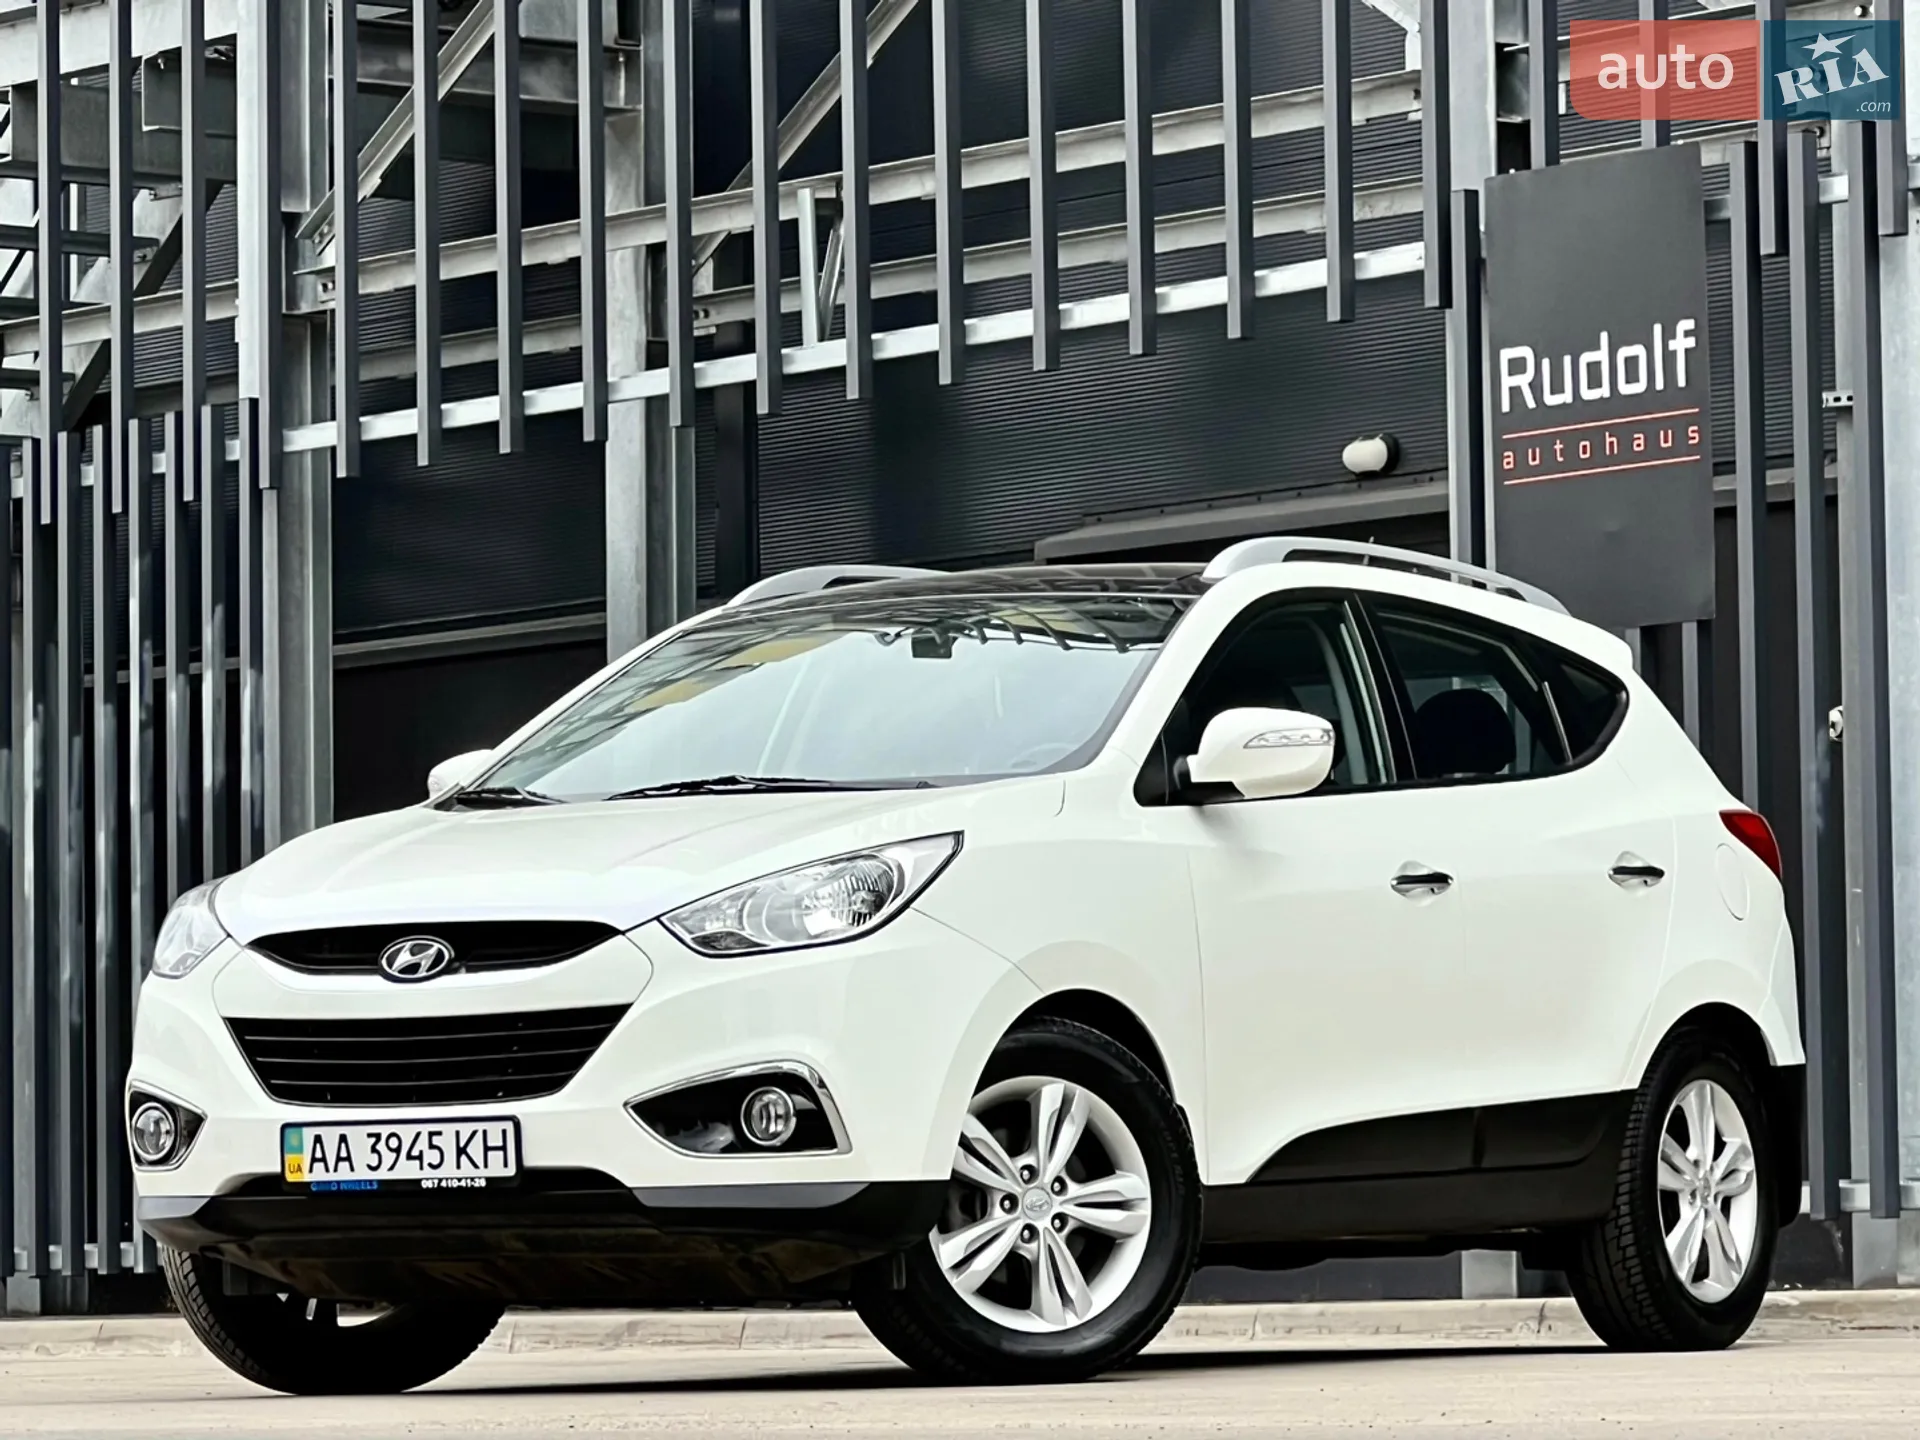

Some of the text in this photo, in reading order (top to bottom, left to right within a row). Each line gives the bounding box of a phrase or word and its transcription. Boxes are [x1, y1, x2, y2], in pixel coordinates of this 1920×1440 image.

[1499, 318, 1696, 413] Rudolf
[1502, 425, 1699, 469] autohaus
[288, 1163, 303, 1174] UA
[308, 1128, 508, 1174] AA 3945 KH
